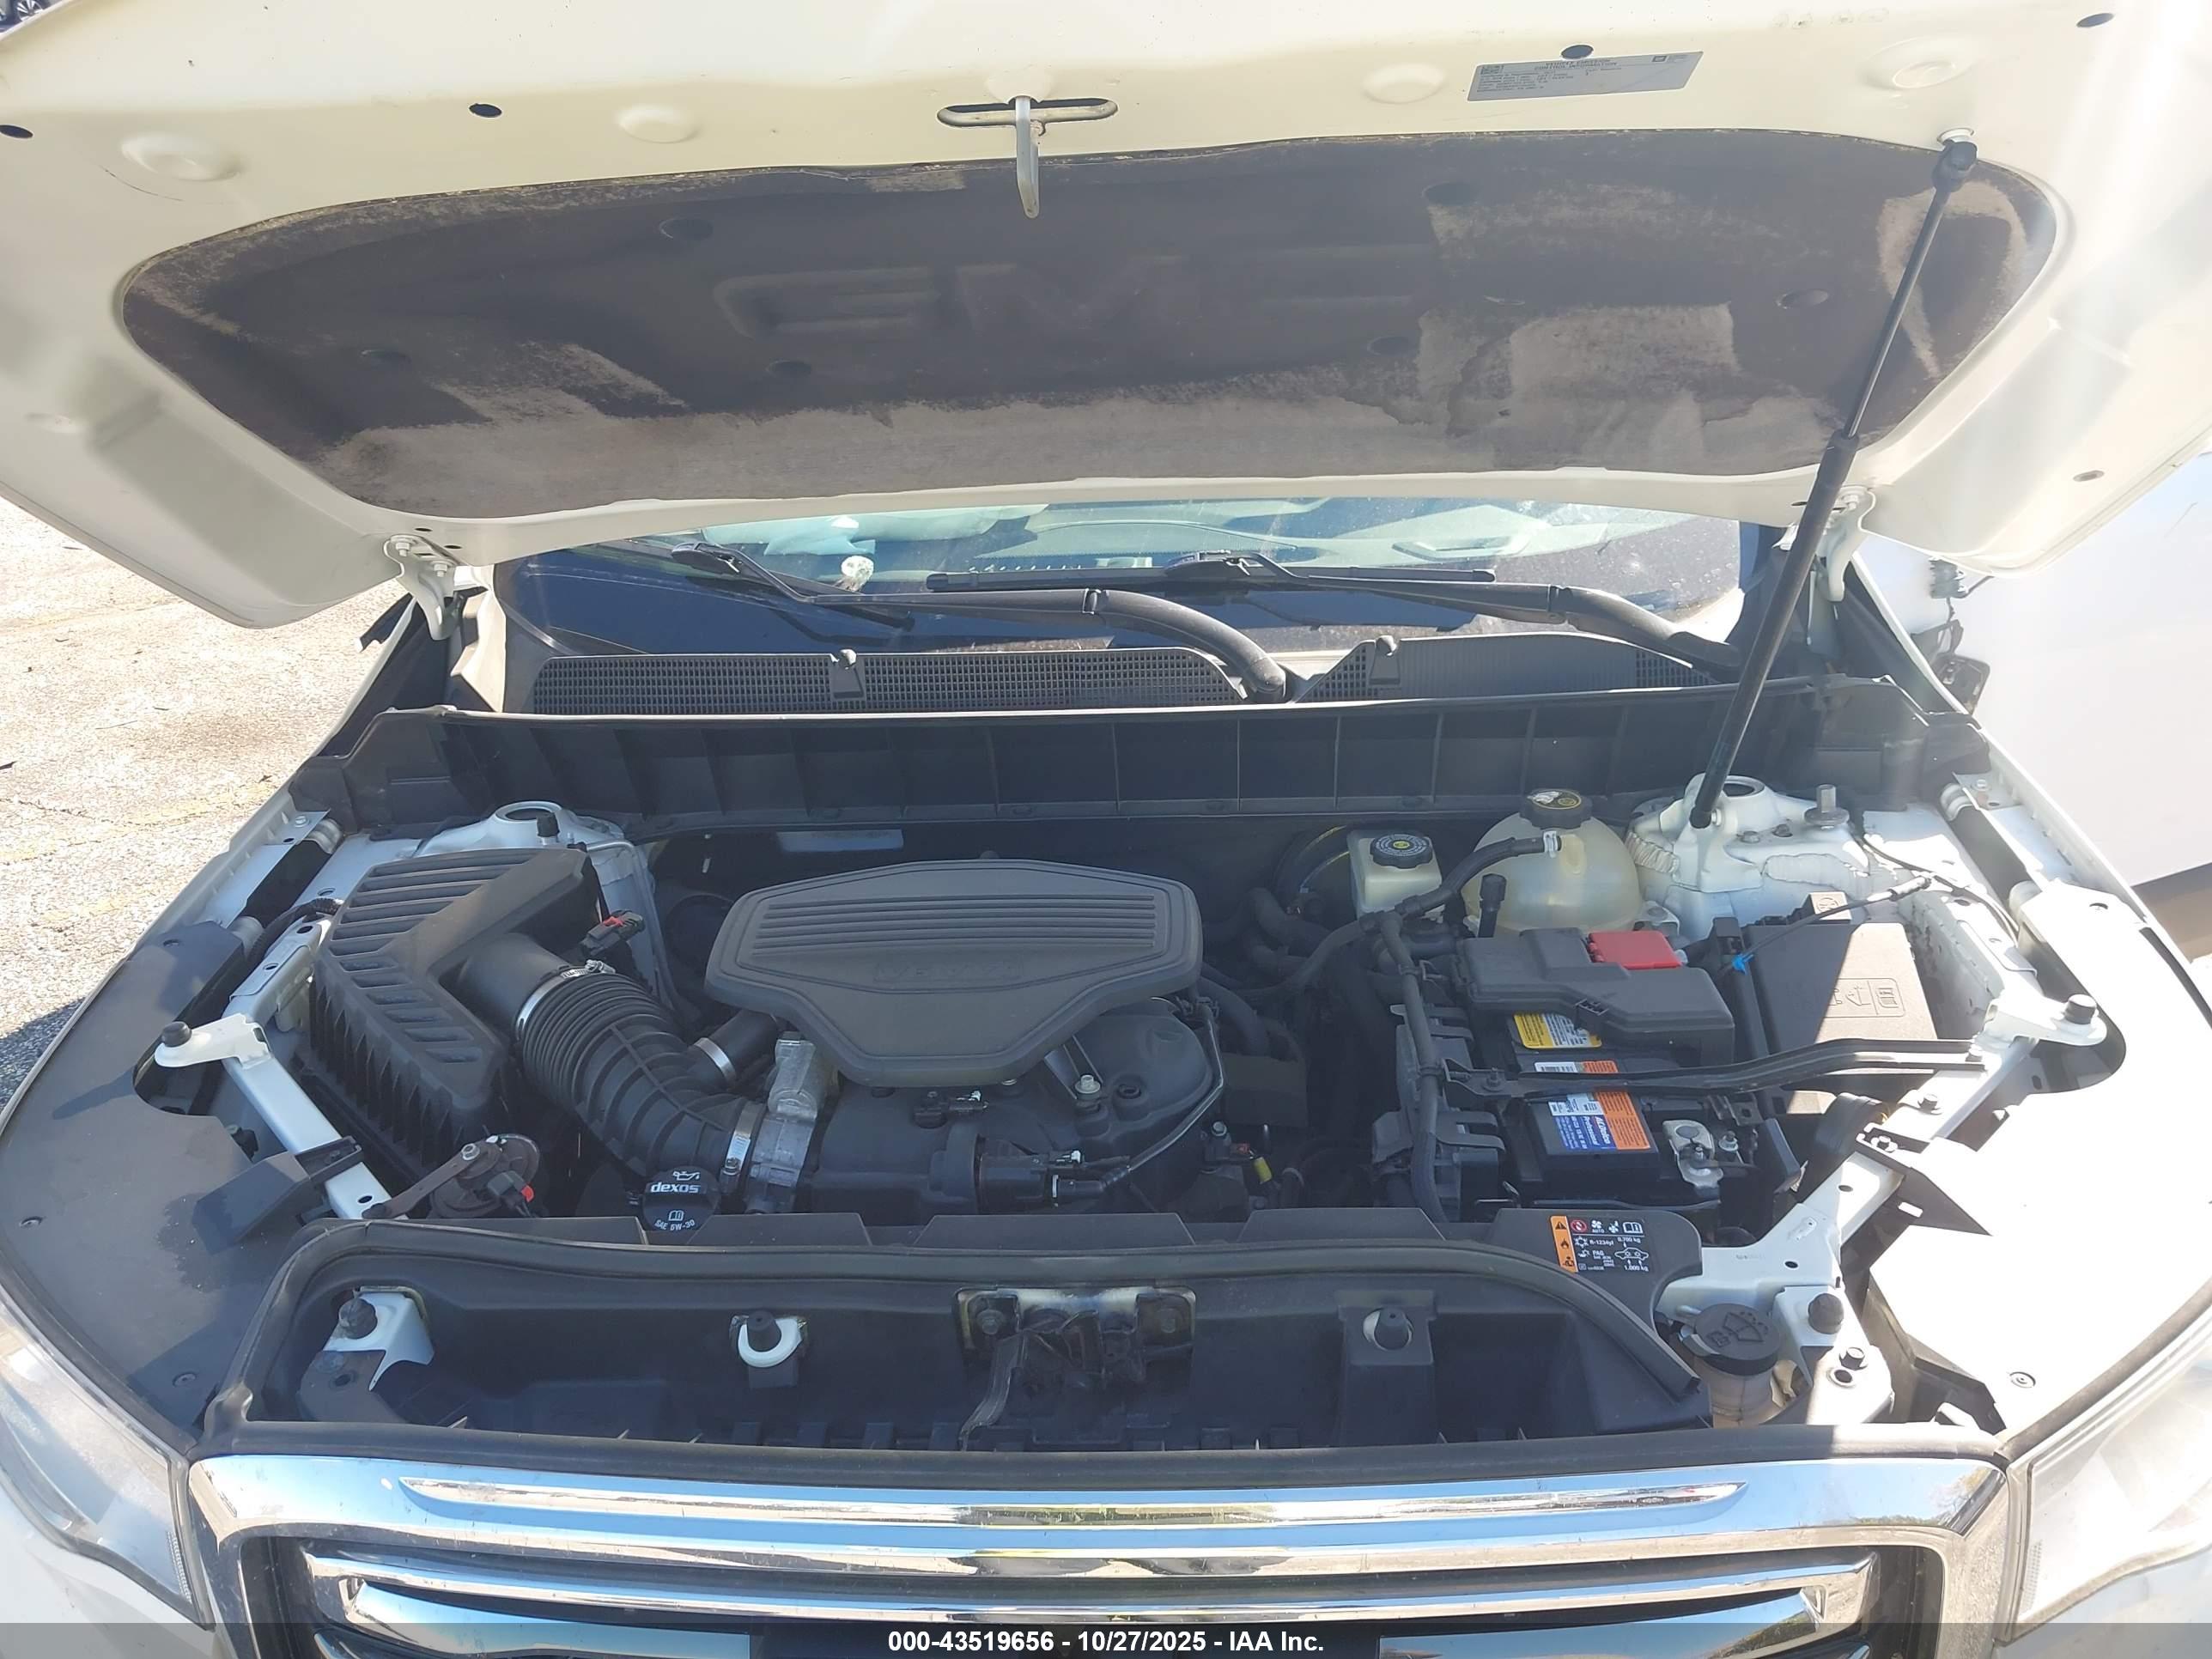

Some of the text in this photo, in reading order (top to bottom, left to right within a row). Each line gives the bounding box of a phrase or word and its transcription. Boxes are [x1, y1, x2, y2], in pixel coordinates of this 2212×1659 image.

[1595, 1115, 1611, 1144] ACDelco
[650, 1182, 701, 1194] dexos
[654, 1219, 668, 1230] SAE
